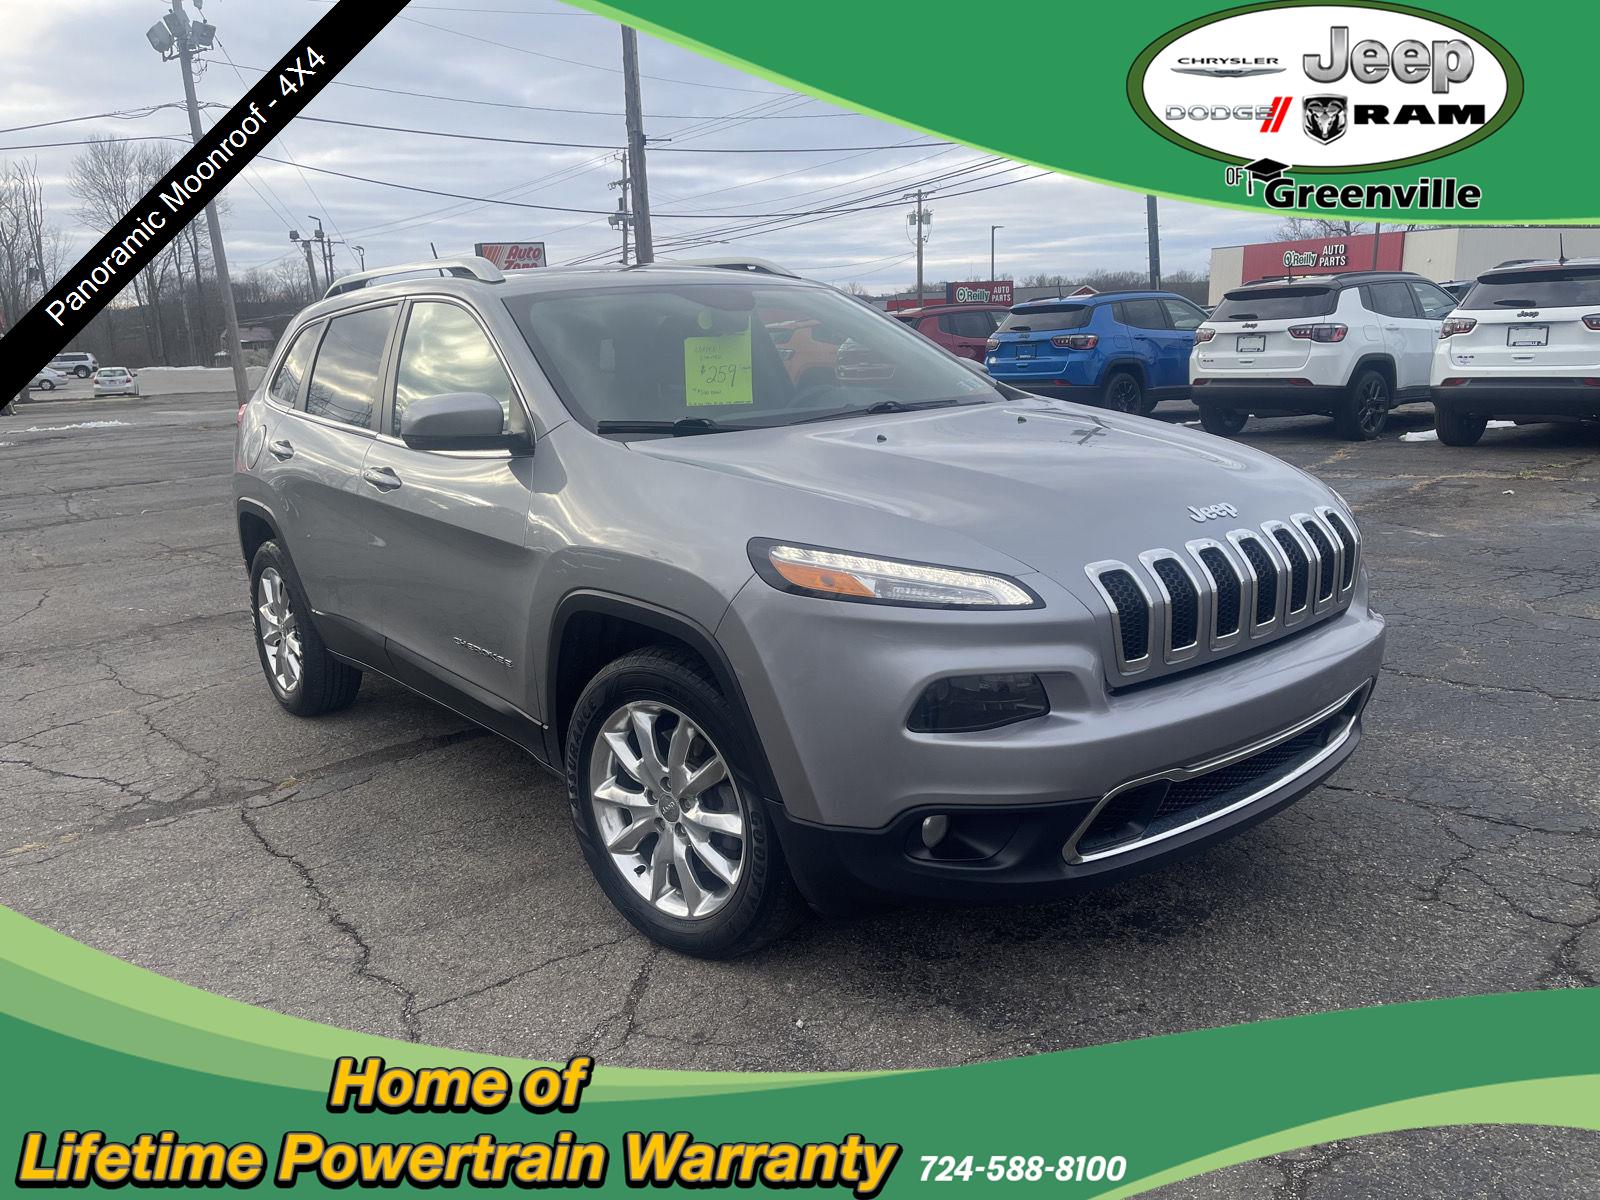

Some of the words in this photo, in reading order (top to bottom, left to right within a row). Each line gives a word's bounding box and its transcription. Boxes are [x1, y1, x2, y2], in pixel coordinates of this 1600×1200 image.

[506, 246, 542, 260] Auto
[1323, 244, 1345, 255] AUTO
[1283, 251, 1317, 267] O'Reilly
[1319, 255, 1346, 267] PARTS
[956, 286, 991, 303] O'Reilly
[993, 286, 1010, 294] AUTO
[991, 294, 1011, 302] PARTS
[1187, 502, 1238, 523] Jeep
